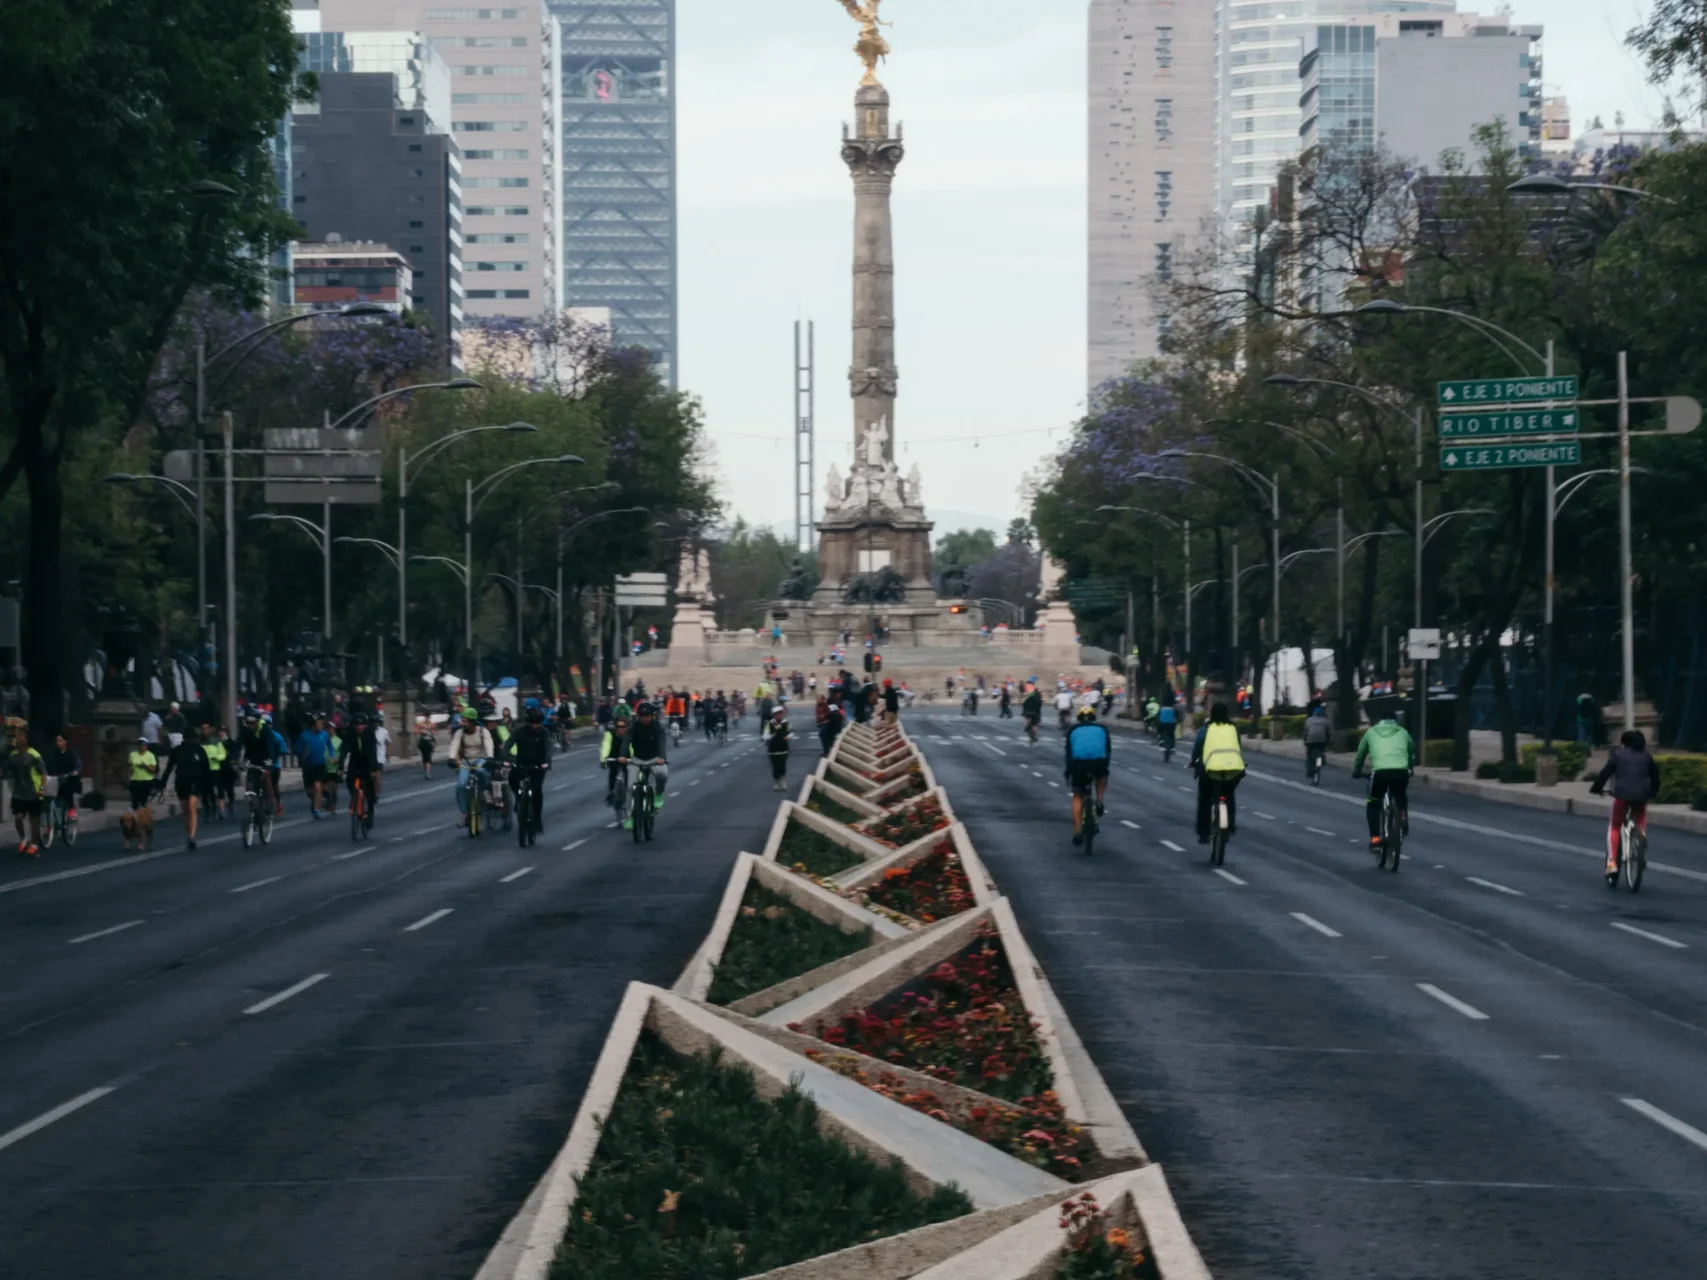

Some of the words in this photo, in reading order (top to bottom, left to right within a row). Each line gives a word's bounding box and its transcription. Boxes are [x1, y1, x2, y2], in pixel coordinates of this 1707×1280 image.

[1462, 384, 1488, 400] EJE
[1493, 383, 1502, 398] 3
[1505, 380, 1575, 397] PONIENTE
[1442, 418, 1480, 433] RIO
[1488, 414, 1553, 431] TIBER
[1464, 450, 1490, 465] EJE
[1495, 449, 1504, 464] 2
[1508, 446, 1577, 463] PONIENTE
